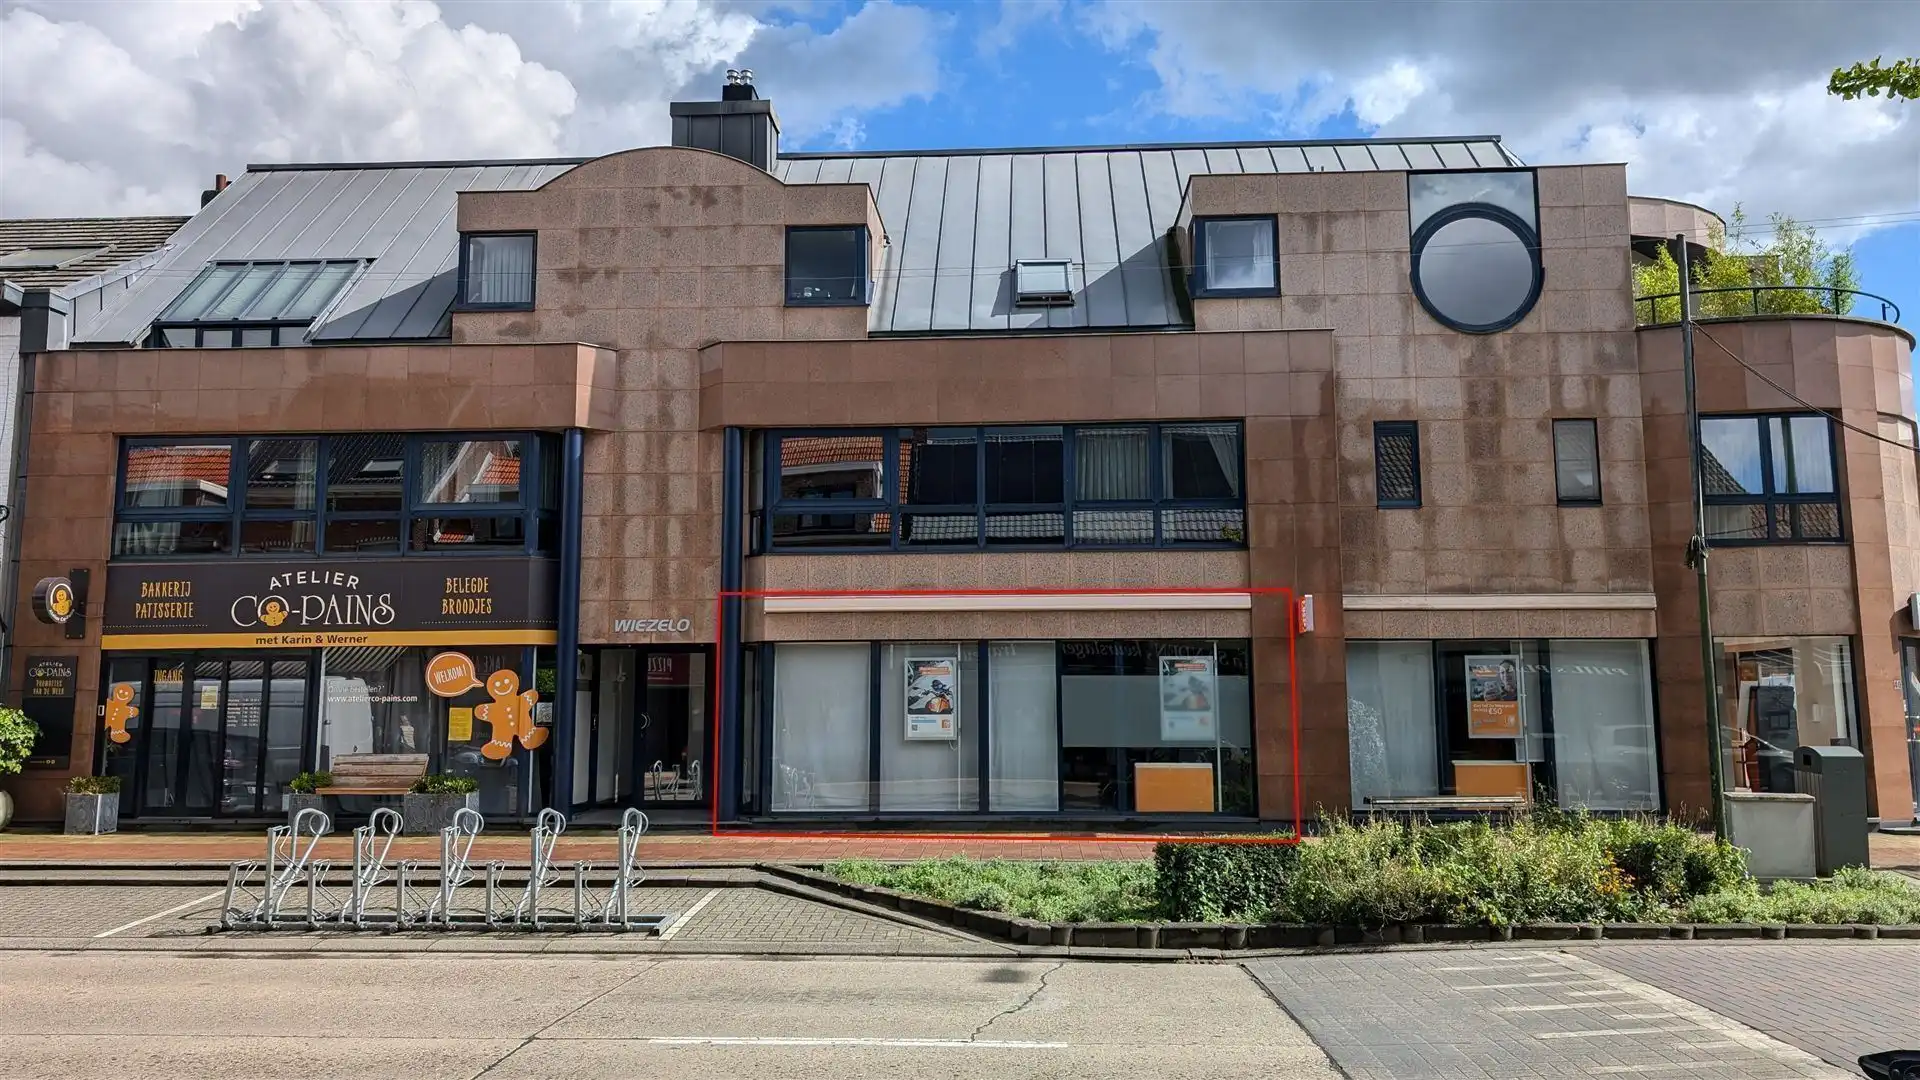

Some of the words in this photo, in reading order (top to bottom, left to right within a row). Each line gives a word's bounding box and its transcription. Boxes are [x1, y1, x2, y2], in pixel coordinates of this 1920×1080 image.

[140, 580, 192, 599] BAKKERIJ
[269, 570, 360, 591] ATELIER
[445, 576, 489, 594] BELEGDE
[135, 601, 194, 620] PATISSERIE
[441, 597, 492, 616] BROODJES
[613, 618, 691, 633] WIEZELO
[255, 635, 279, 646] met
[281, 634, 312, 645] Karin
[315, 634, 324, 645] &
[326, 634, 369, 645] Werner
[153, 669, 184, 683] INGANG
